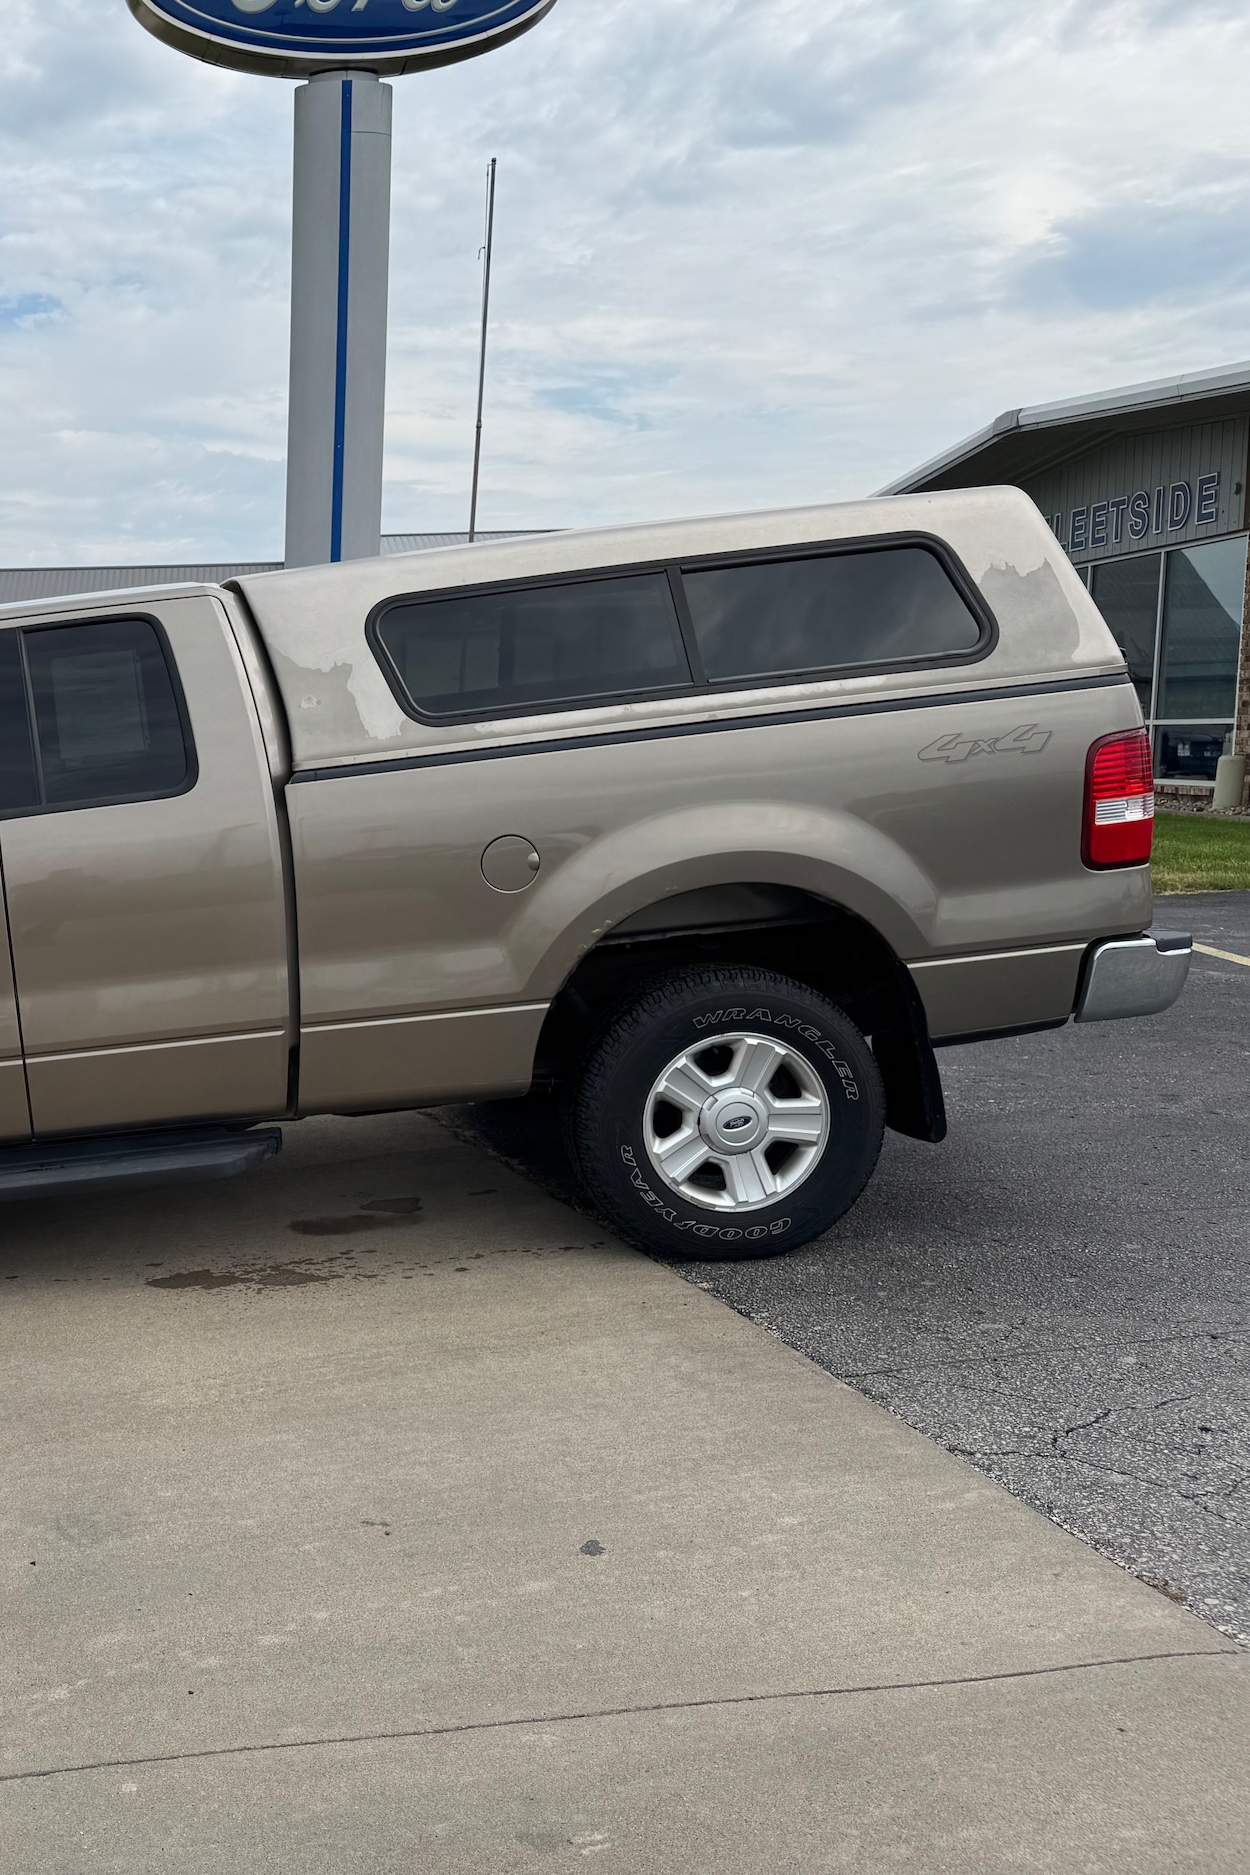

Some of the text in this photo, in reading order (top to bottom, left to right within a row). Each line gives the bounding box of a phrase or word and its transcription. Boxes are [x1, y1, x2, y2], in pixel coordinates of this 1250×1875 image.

[1044, 472, 1219, 553] LEETSIDE
[918, 723, 1053, 763] 4x4
[693, 1008, 859, 1100] WRANGLER
[620, 1145, 792, 1240] GOODYEAR
